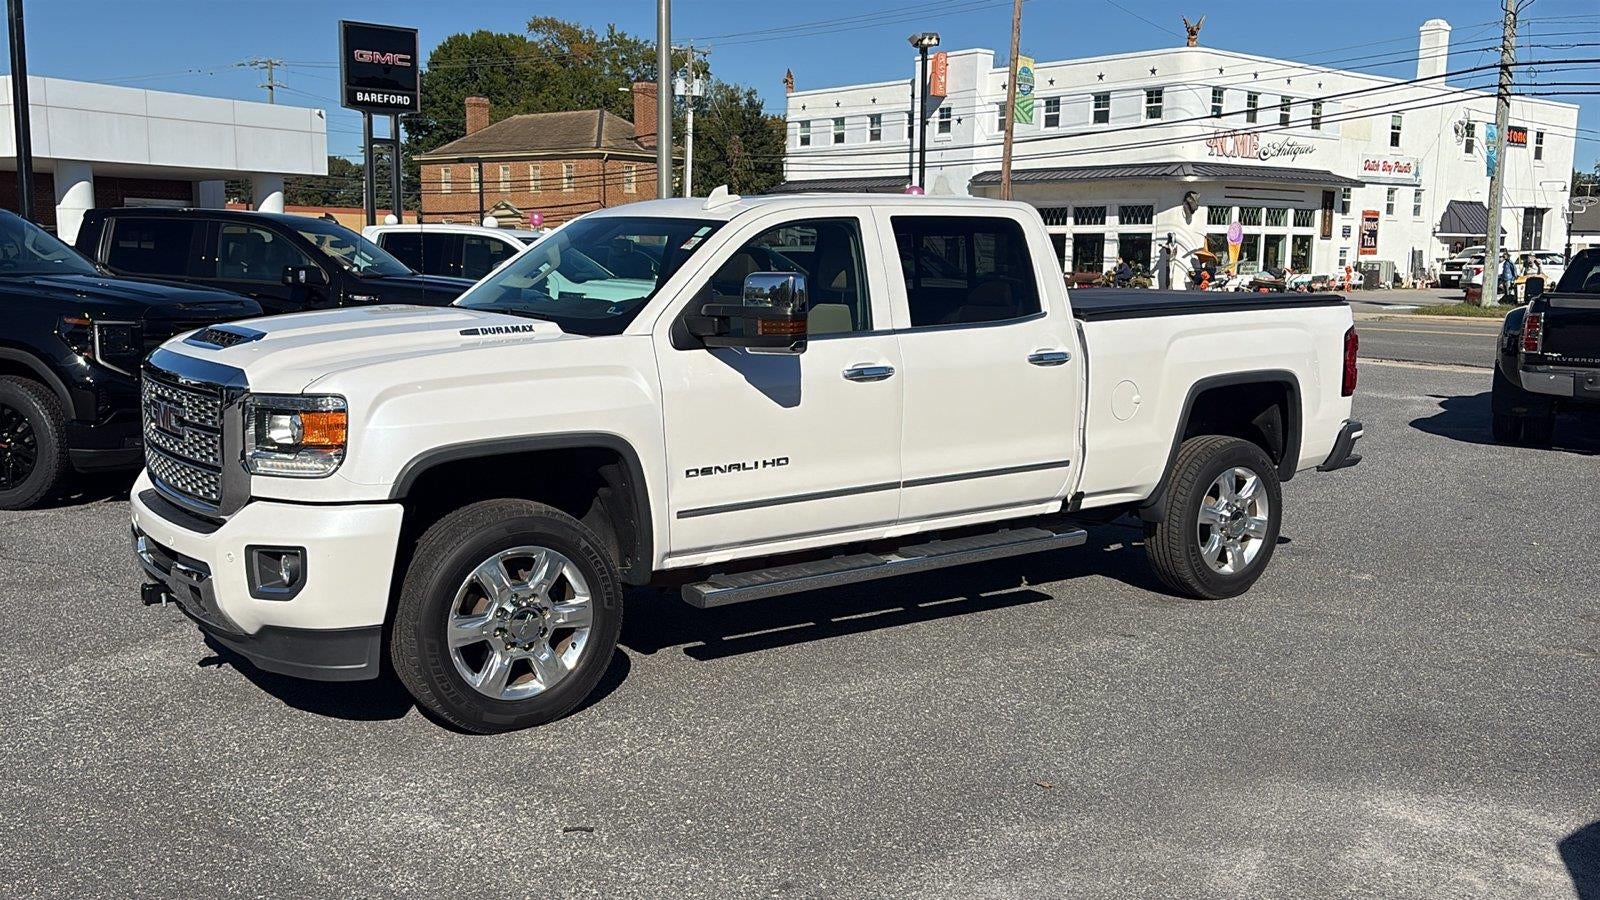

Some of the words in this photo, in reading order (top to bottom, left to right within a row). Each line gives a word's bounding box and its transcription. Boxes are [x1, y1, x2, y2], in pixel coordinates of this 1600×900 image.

[354, 49, 411, 67] GMC
[356, 91, 410, 105] BAREFORD
[1206, 129, 1259, 159] ACME
[1259, 137, 1316, 162] Antiques
[1363, 159, 1380, 171] Dutch
[1381, 160, 1393, 175] Boy
[1393, 161, 1412, 173] Paints
[1363, 235, 1375, 246] TEA
[480, 324, 535, 336] DURAMAX
[150, 399, 185, 435] GMC
[685, 460, 758, 478] DENALI
[762, 456, 789, 468] HD
[580, 542, 615, 608] MICHELIN
